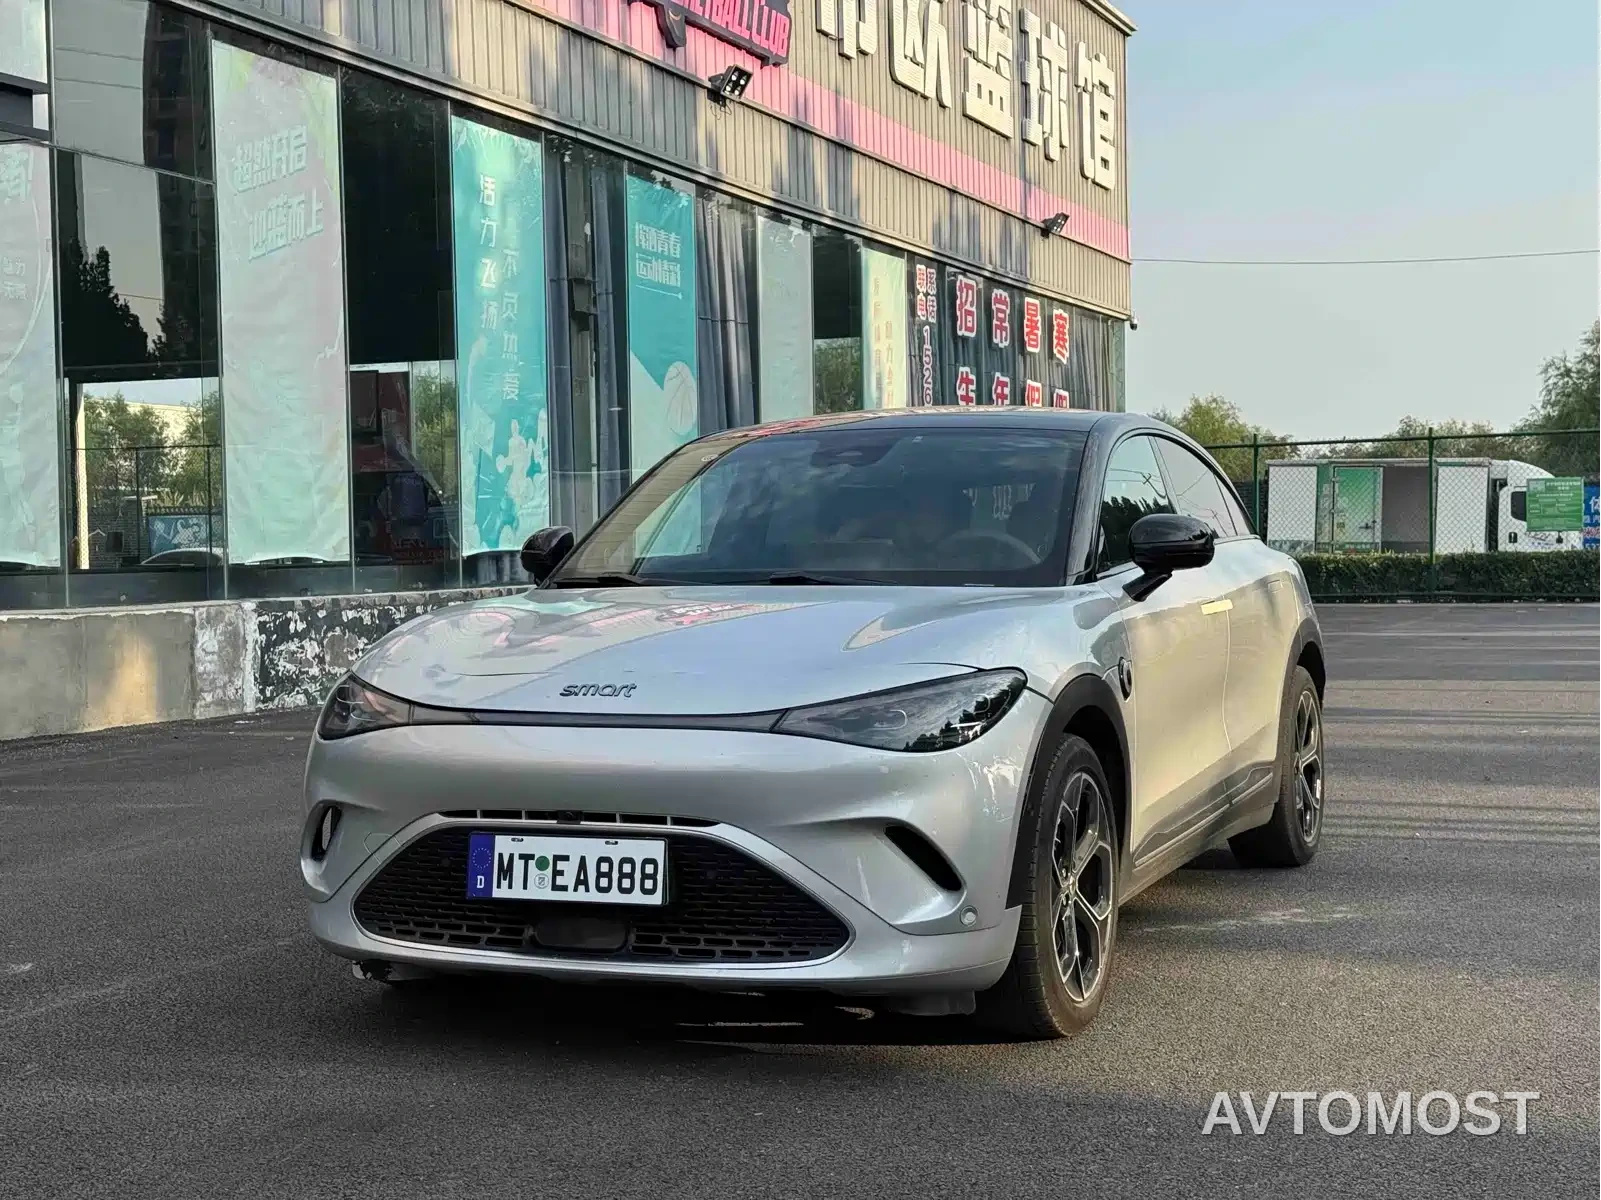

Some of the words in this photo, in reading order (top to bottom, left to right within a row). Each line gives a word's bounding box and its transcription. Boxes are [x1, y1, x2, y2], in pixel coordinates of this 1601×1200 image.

[751, 0, 791, 58] CLUB
[479, 174, 497, 330] 活力飞扬
[922, 325, 933, 406] 1526
[559, 683, 638, 698] smart
[476, 875, 485, 888] D
[496, 852, 535, 890] MT
[551, 854, 659, 896] EA888
